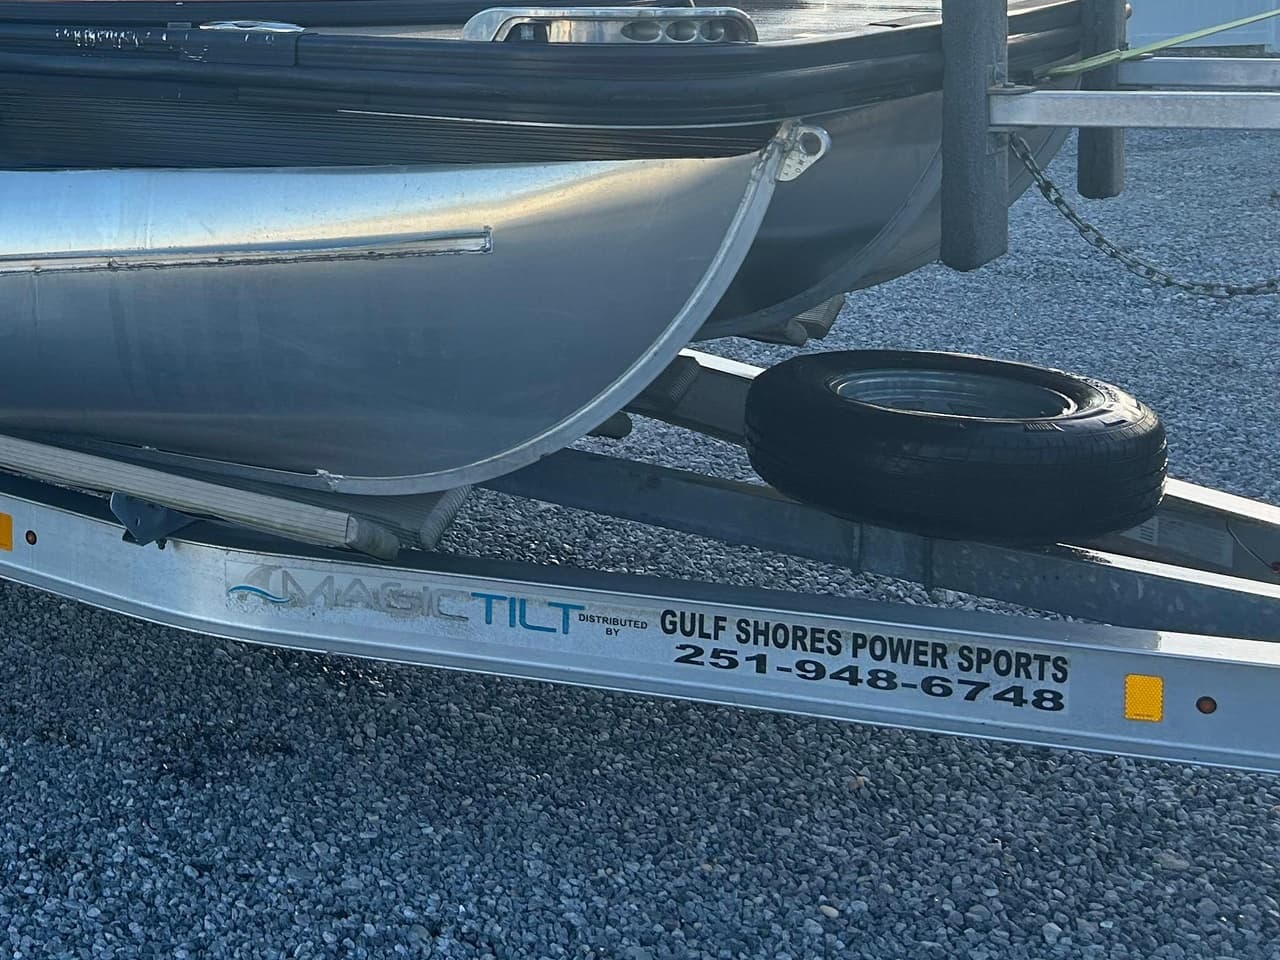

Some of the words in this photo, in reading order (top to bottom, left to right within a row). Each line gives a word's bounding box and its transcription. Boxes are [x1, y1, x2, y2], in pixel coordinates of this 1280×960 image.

[578, 613, 648, 630] DISTRIBUTED
[605, 627, 620, 637] BY
[660, 609, 728, 641] GULF
[735, 618, 843, 656] SHORES
[851, 632, 949, 670] POWER
[957, 645, 1069, 684] SPORTS
[673, 643, 1066, 713] 251-948-6748
